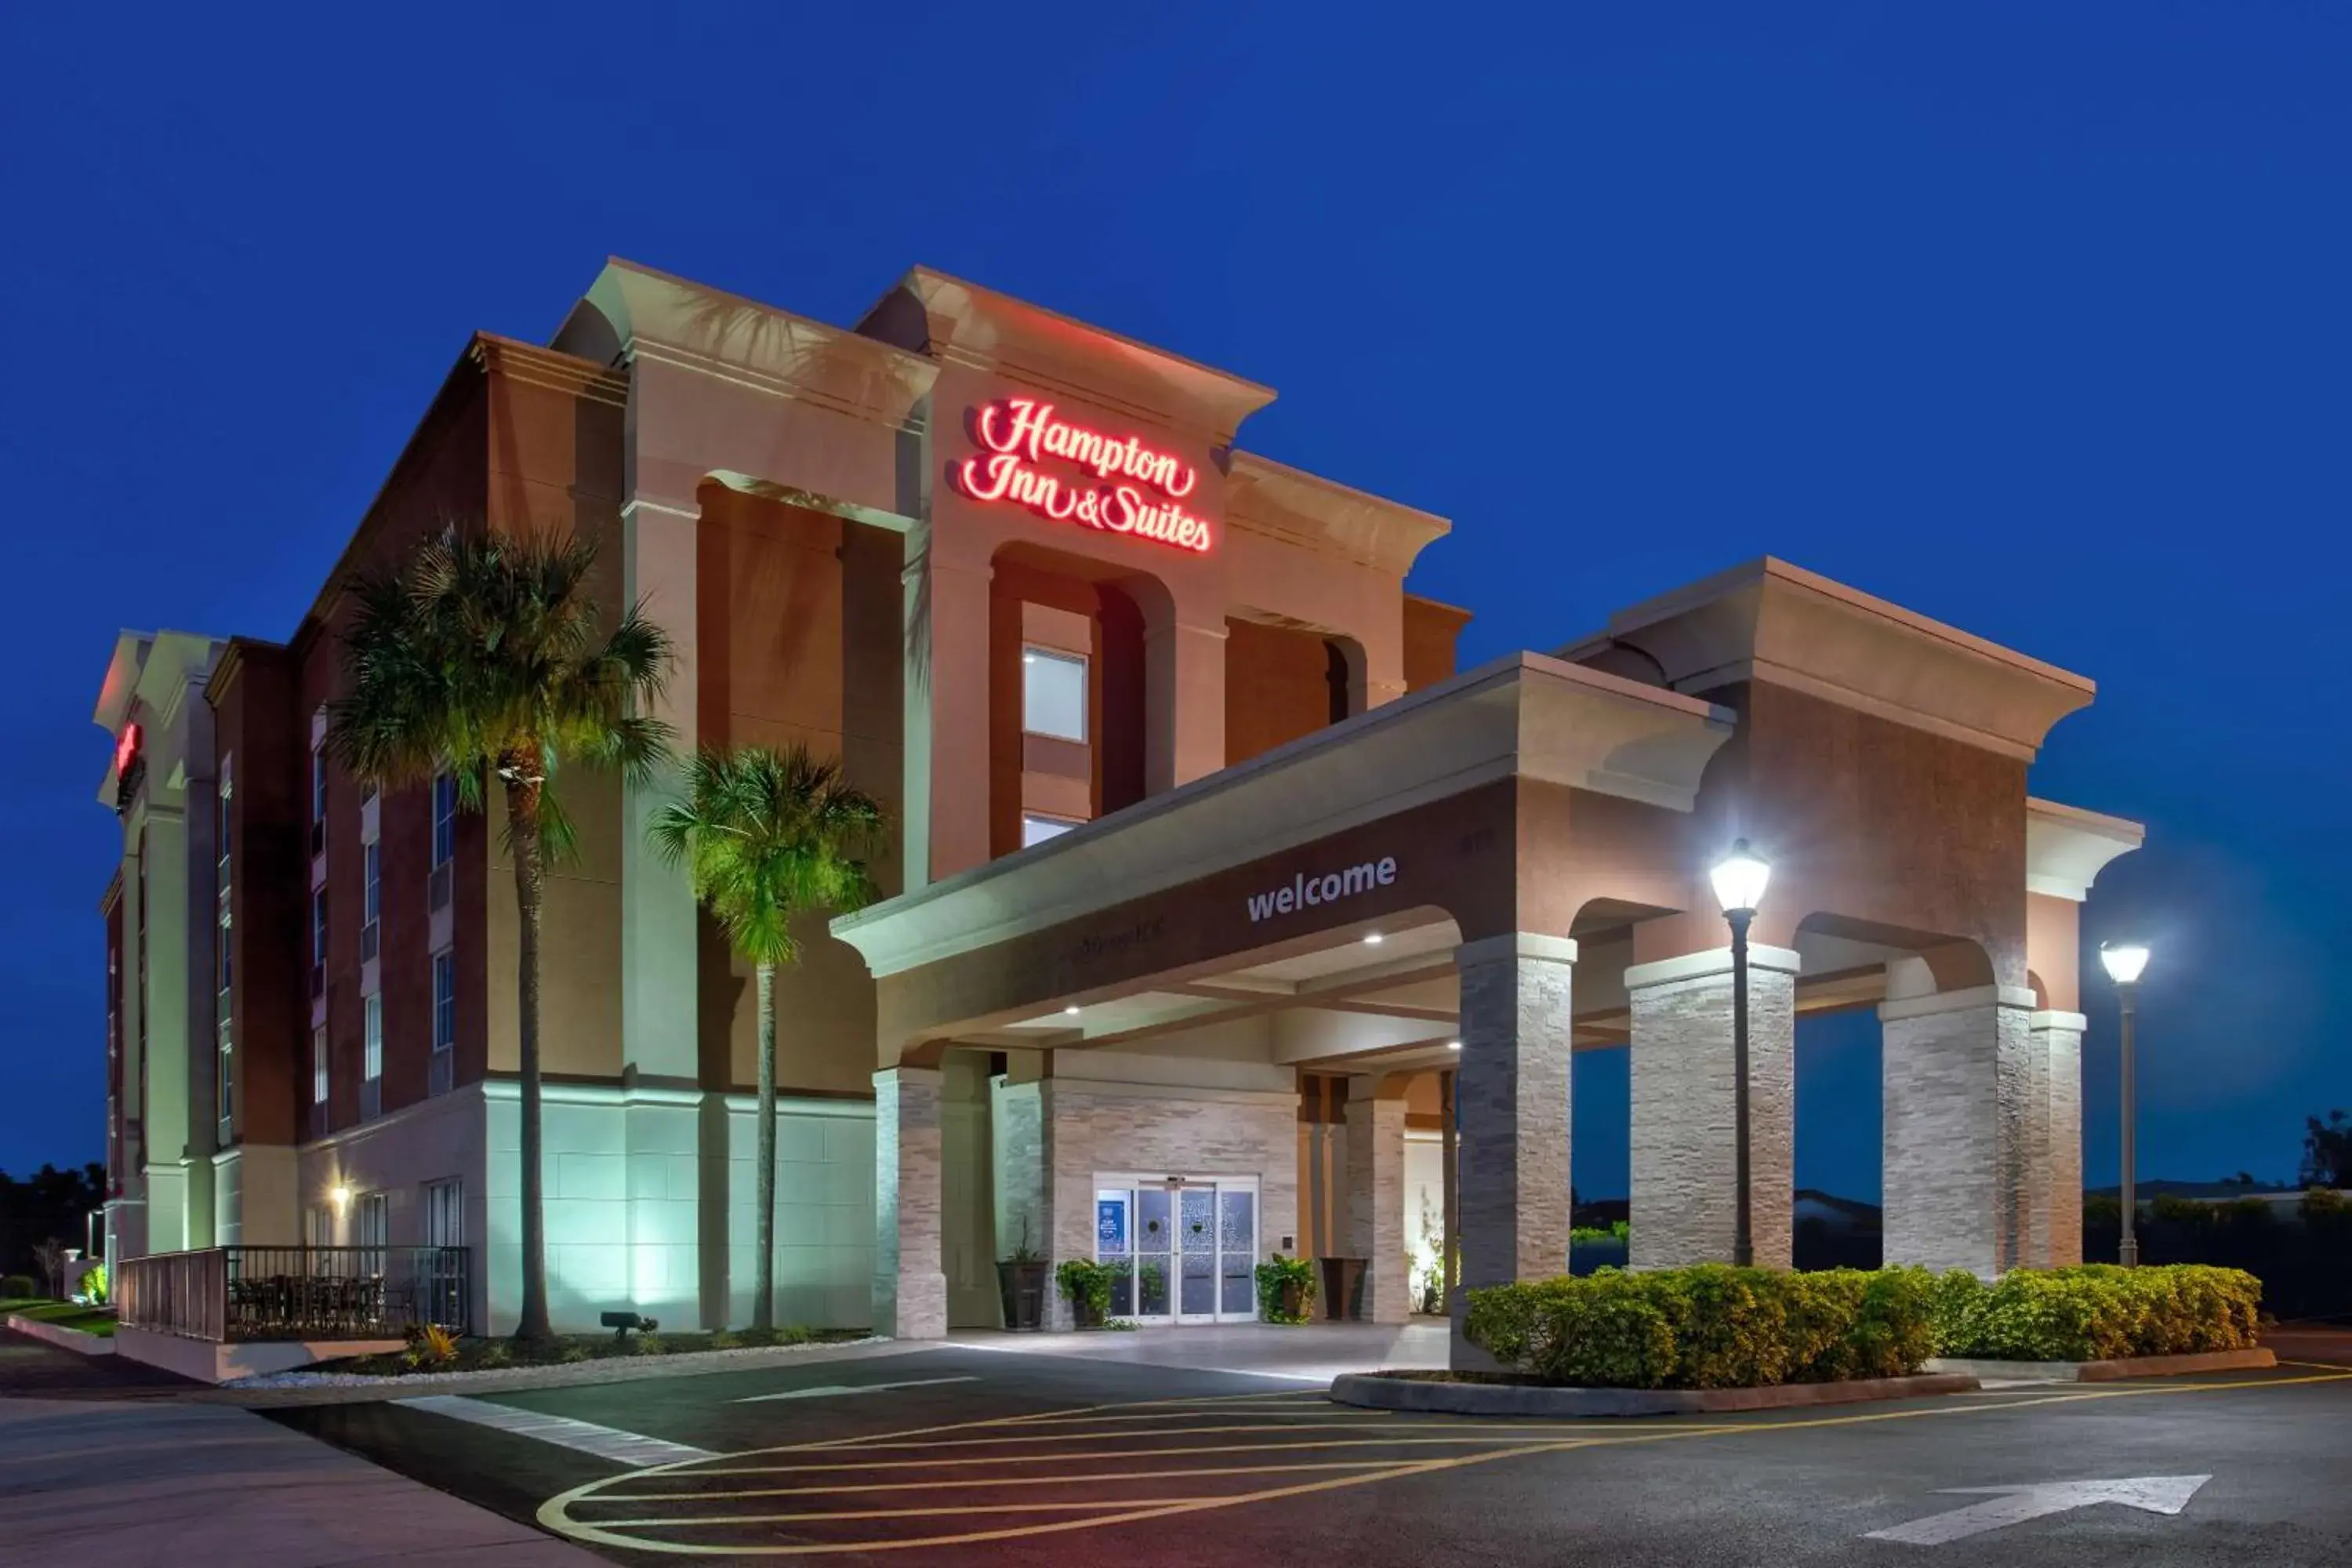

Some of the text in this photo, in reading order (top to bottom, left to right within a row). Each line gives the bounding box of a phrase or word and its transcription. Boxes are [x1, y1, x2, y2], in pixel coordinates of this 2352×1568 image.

[982, 400, 1195, 497] Hampton
[963, 454, 1076, 518] Inn
[1100, 486, 1210, 552] Suites
[1247, 855, 1397, 923] welcome
